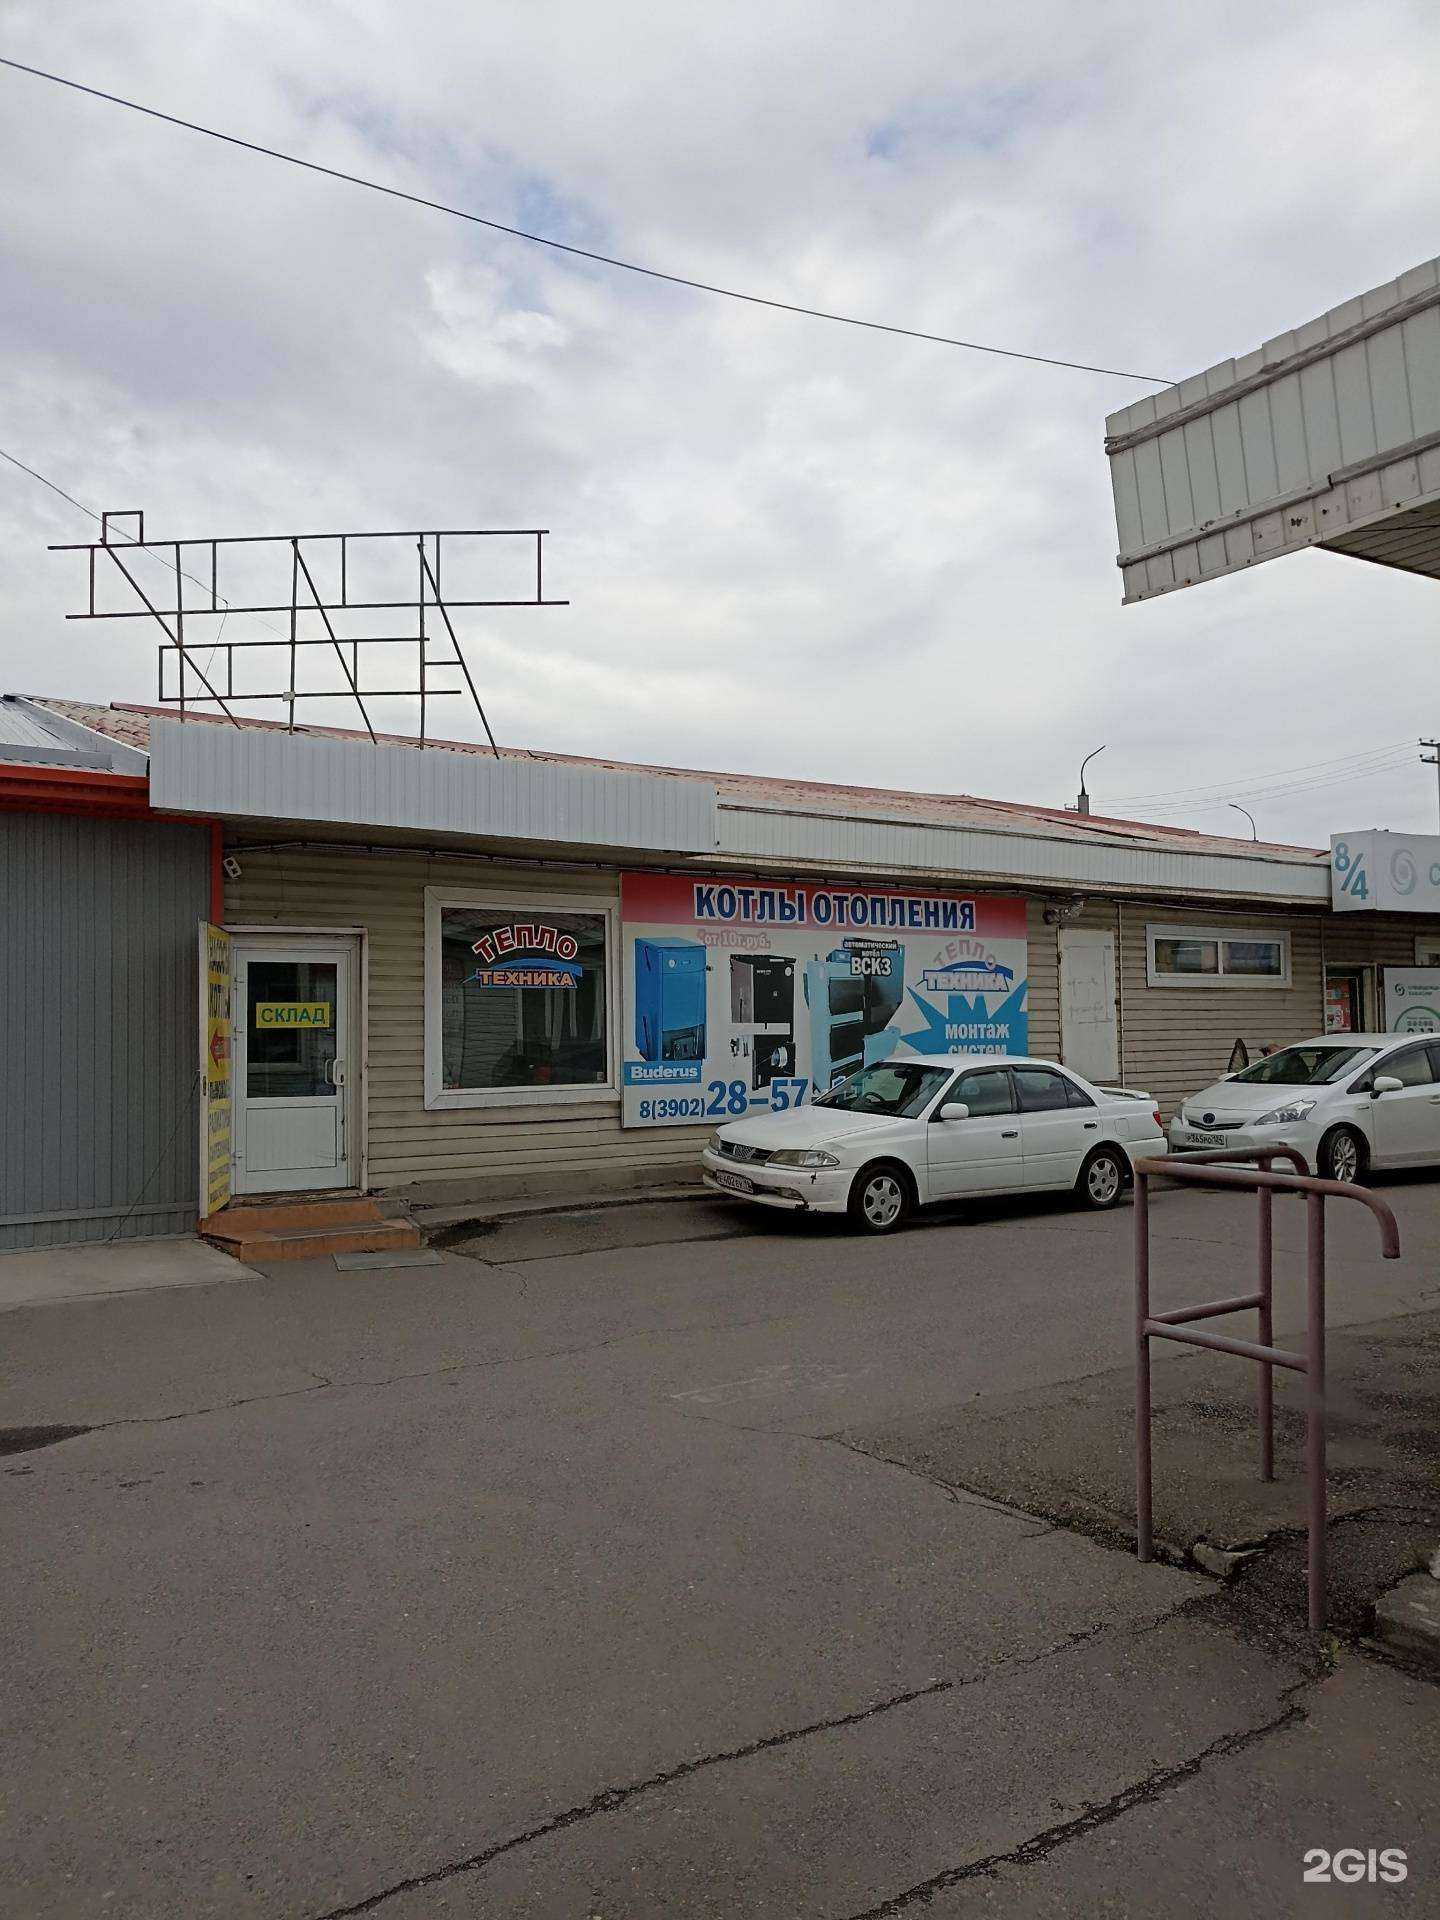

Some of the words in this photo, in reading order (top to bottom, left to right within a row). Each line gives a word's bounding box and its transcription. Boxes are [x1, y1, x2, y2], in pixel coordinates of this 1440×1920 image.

[1335, 842, 1369, 900] 8/4
[694, 884, 805, 923] КОТЛЫ
[812, 891, 976, 931] ОТОПЛЕНИЯ
[472, 924, 578, 963] ТЕПЛО
[843, 940, 897, 950] автоматический
[933, 940, 997, 970] ТЕПЛО
[478, 970, 574, 987] ТЕХНИКА
[926, 971, 1009, 991] ТЕХНИКА
[261, 1007, 326, 1025] СКЛАД
[630, 1065, 698, 1079] Buderus
